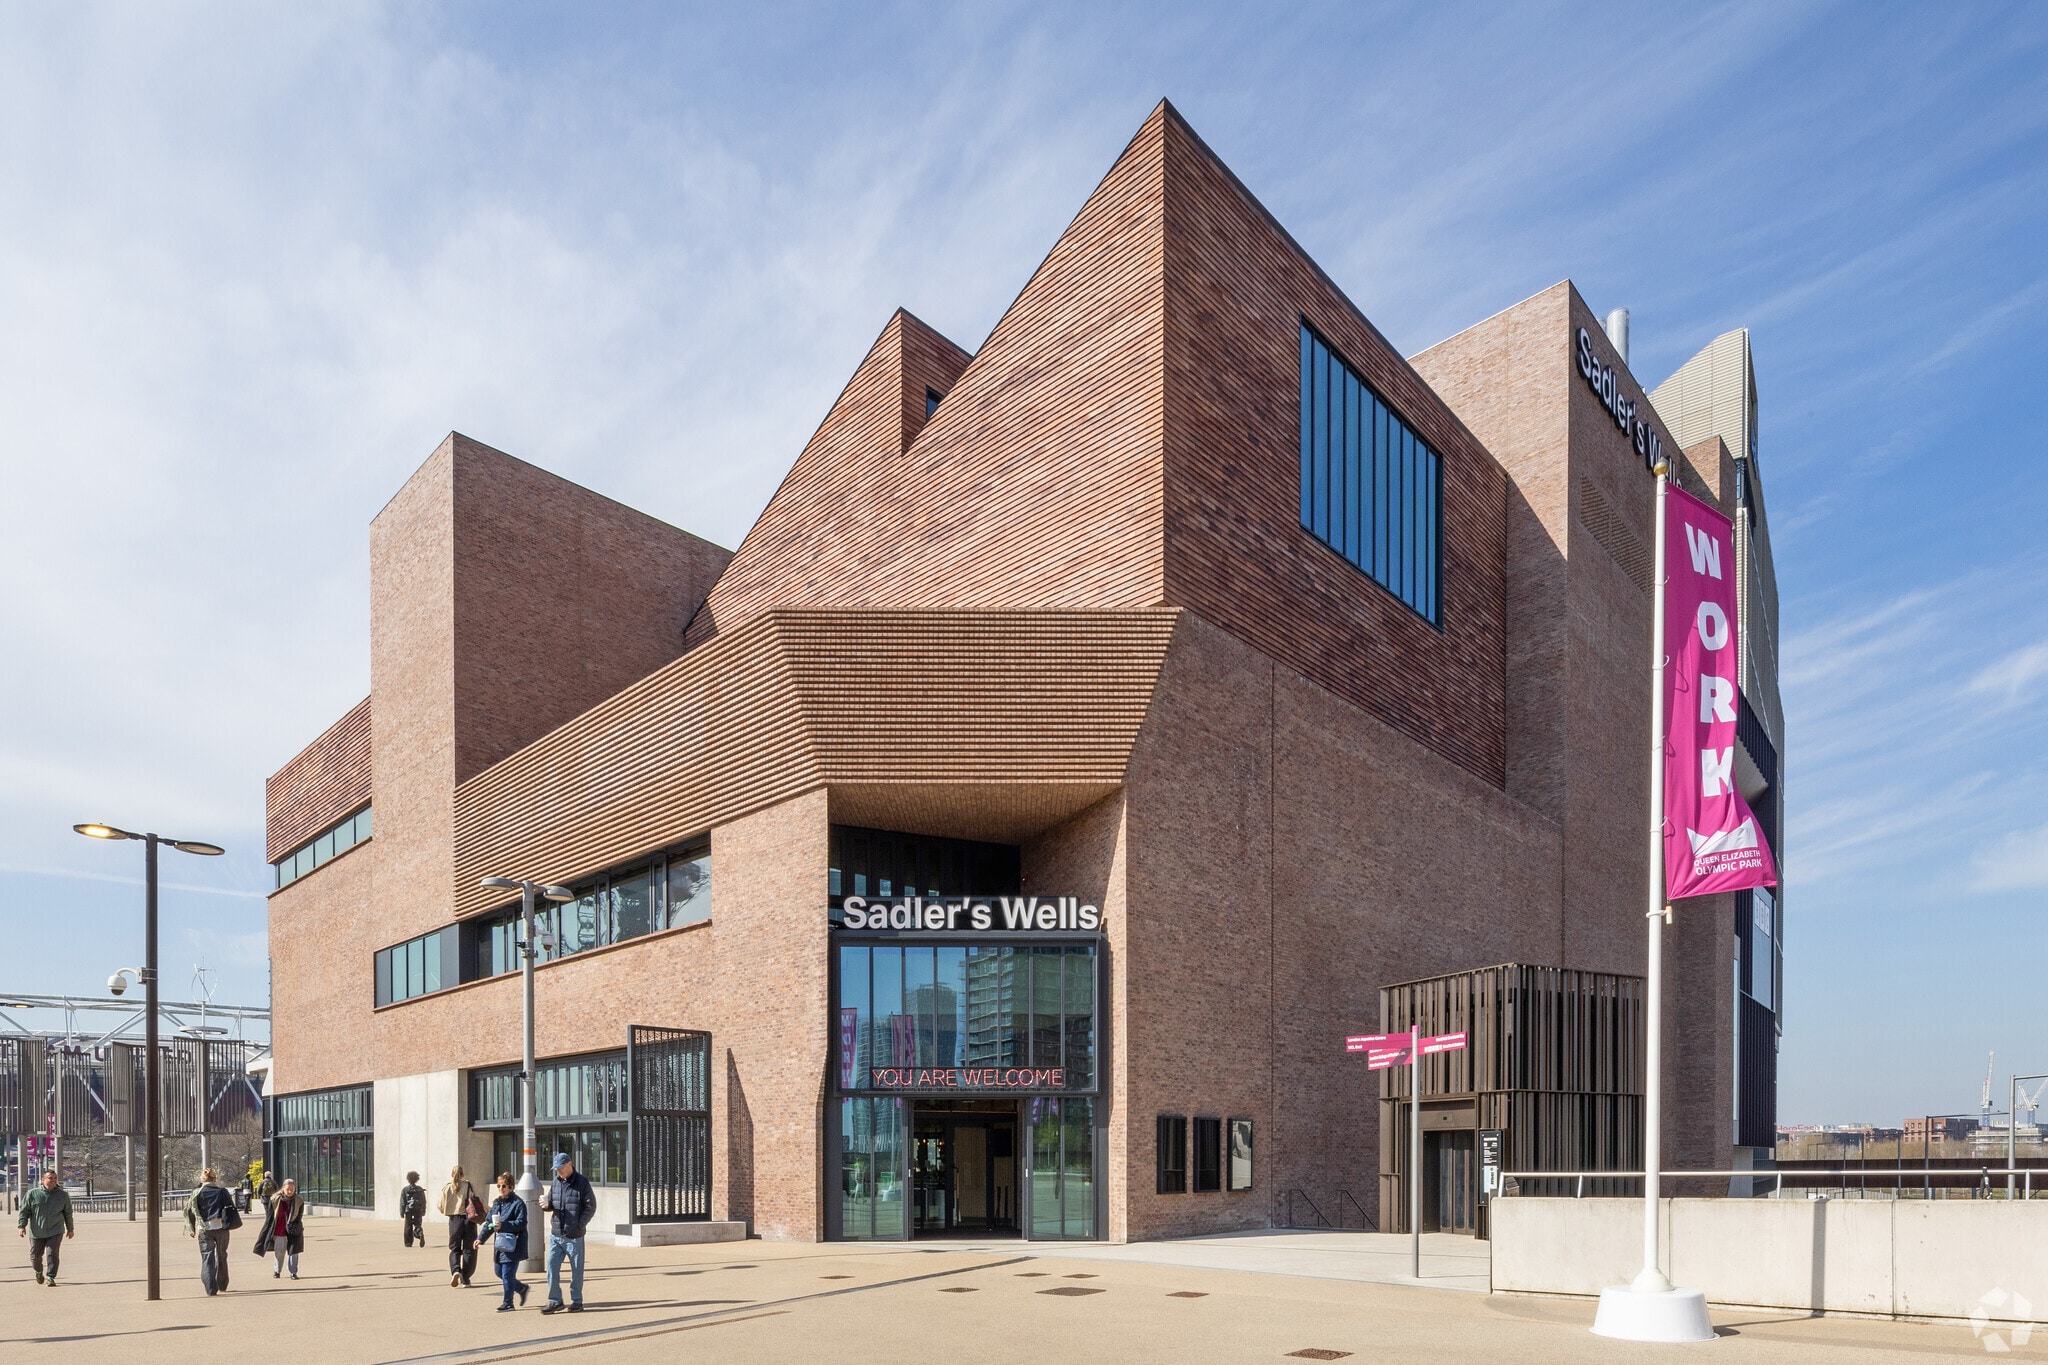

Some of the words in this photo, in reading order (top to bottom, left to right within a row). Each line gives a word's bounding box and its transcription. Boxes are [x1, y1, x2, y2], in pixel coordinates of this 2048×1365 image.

[1576, 327, 1645, 455] Sadler's
[1684, 521, 1738, 797] WORK
[1693, 855, 1720, 866] QUEEN
[1721, 849, 1761, 862] ELIZABETH
[1695, 861, 1738, 876] OLYMPIC
[1739, 858, 1763, 870] PARK
[843, 896, 991, 930] Sadler's
[1000, 896, 1099, 930] Wells
[871, 1068, 913, 1087] YOU
[917, 1068, 958, 1087] ARE
[962, 1068, 1064, 1087] WELCOME
